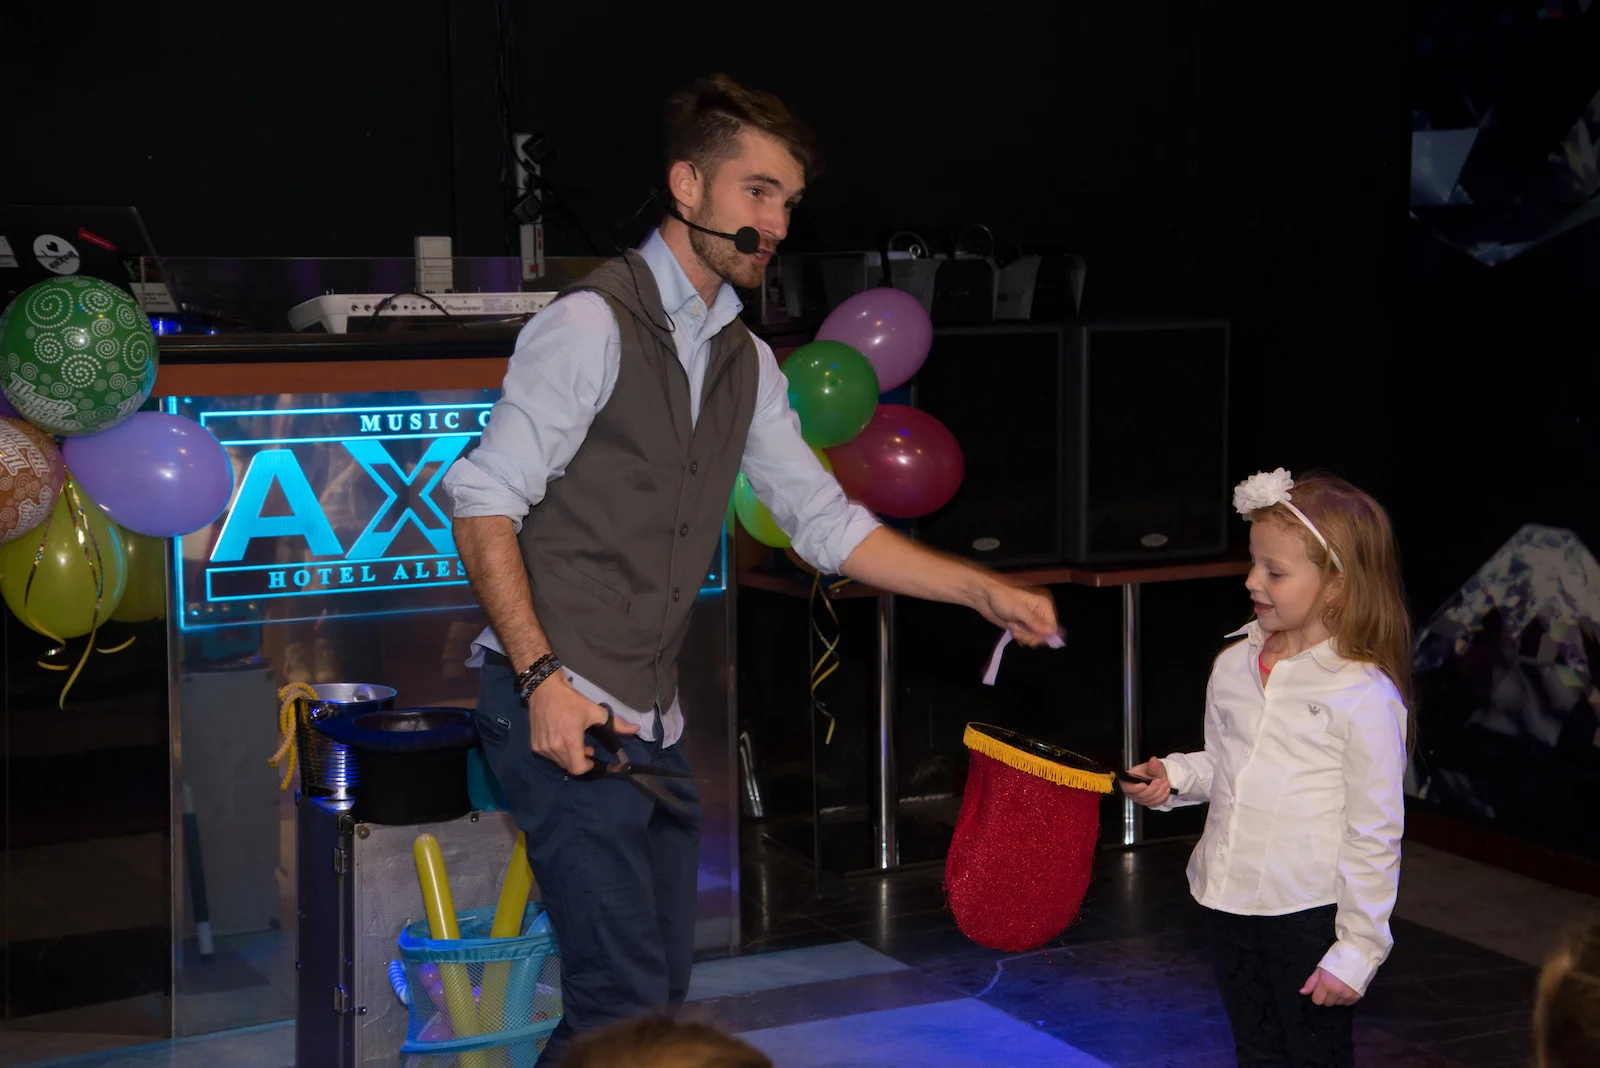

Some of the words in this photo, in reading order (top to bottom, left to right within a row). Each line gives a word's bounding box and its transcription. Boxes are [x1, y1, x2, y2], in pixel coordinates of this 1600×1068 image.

[8, 372, 77, 416] Happy
[360, 410, 460, 432] MUSIC
[269, 565, 377, 589] HOTEL
[393, 559, 467, 580] ALES
